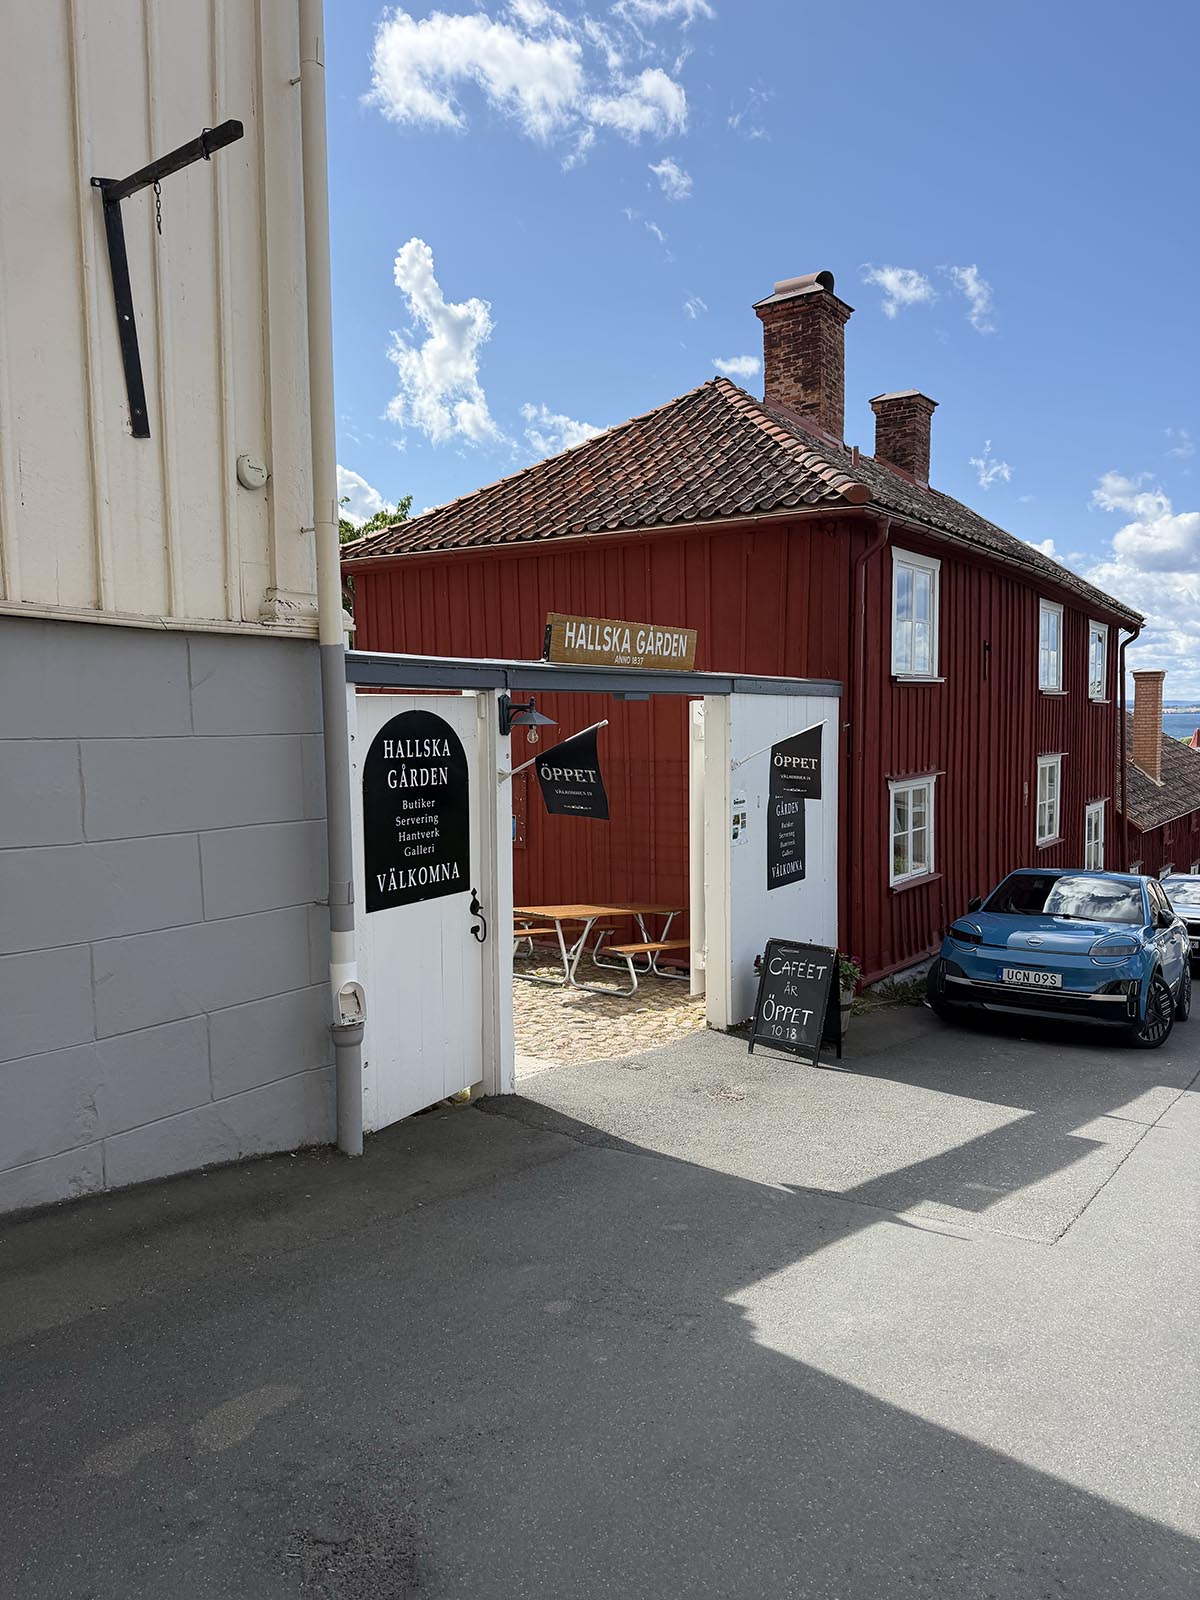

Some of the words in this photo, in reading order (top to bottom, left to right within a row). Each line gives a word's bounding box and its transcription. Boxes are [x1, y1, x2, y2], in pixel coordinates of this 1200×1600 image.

[564, 621, 631, 653] HALLSKA
[636, 626, 688, 657] GÅRDEN
[614, 655, 631, 665] ANNO
[631, 656, 644, 666] 1837
[383, 738, 451, 759] HALLSKA
[773, 752, 818, 770] ÖPPET
[387, 763, 449, 789] GÅRDEN
[540, 763, 596, 783] ÖPPET
[402, 799, 436, 810] Butiker
[775, 800, 799, 817] GÅRDEN
[395, 814, 439, 827] Servering
[398, 828, 440, 842] Hantverk
[404, 844, 435, 857] Galleri
[376, 861, 460, 893] VÄLKOMNA
[771, 859, 803, 879] VÄLKOMNA
[769, 957, 828, 980] CAFÉET
[1007, 969, 1030, 982] UCN
[1033, 972, 1057, 985] 09S
[762, 993, 814, 1026] ÖPPET
